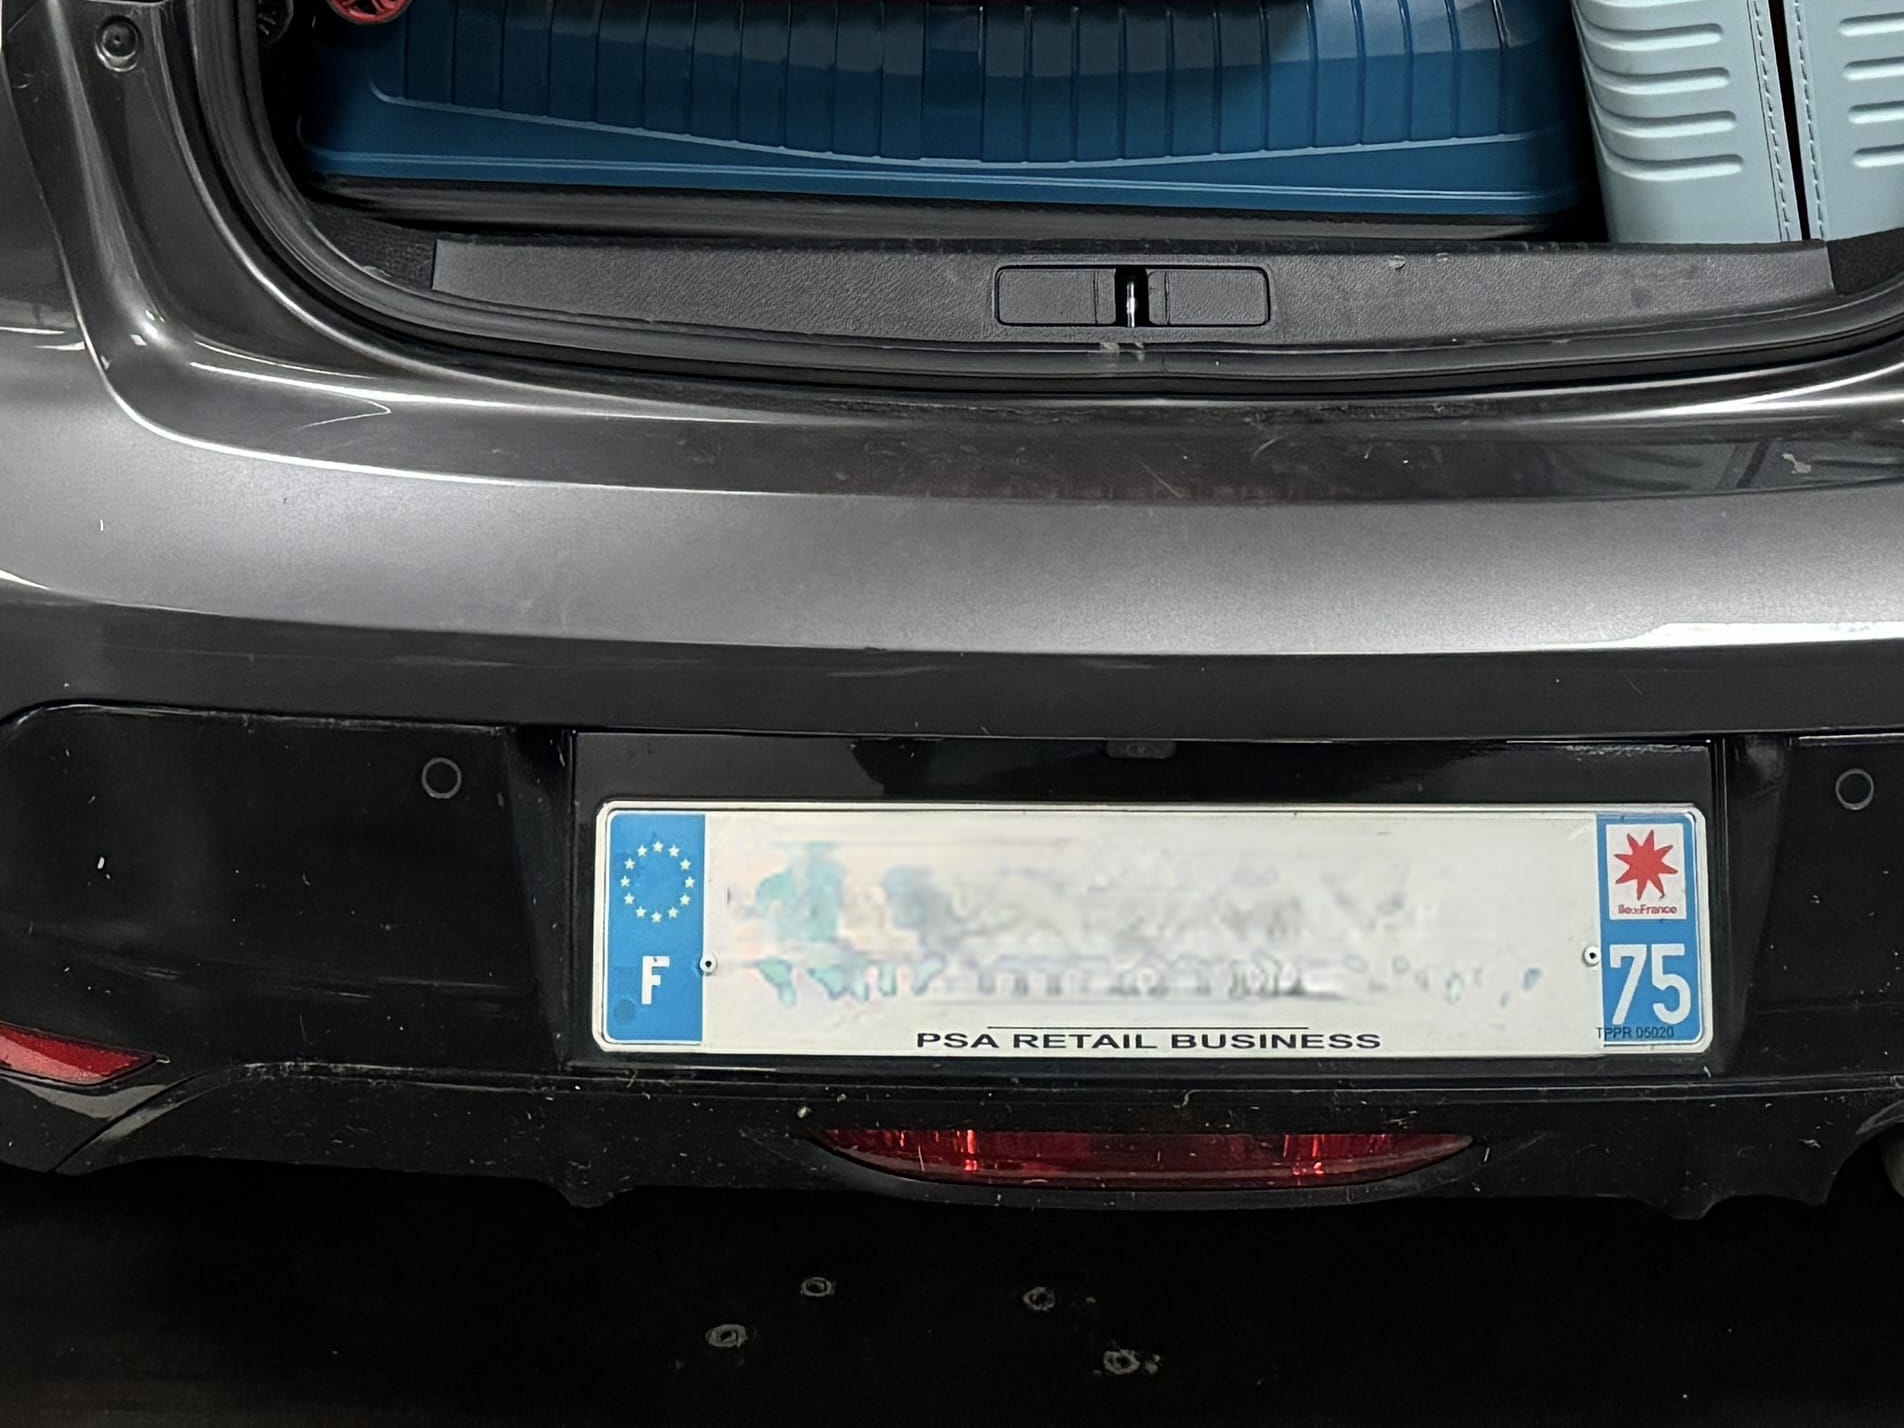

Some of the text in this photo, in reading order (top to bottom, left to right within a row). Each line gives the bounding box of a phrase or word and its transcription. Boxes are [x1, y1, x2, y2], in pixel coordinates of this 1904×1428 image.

[640, 955, 671, 1005] F
[1609, 943, 1692, 1025] 75
[916, 1032, 1382, 1050] PSA RETAIL BUSINESS
